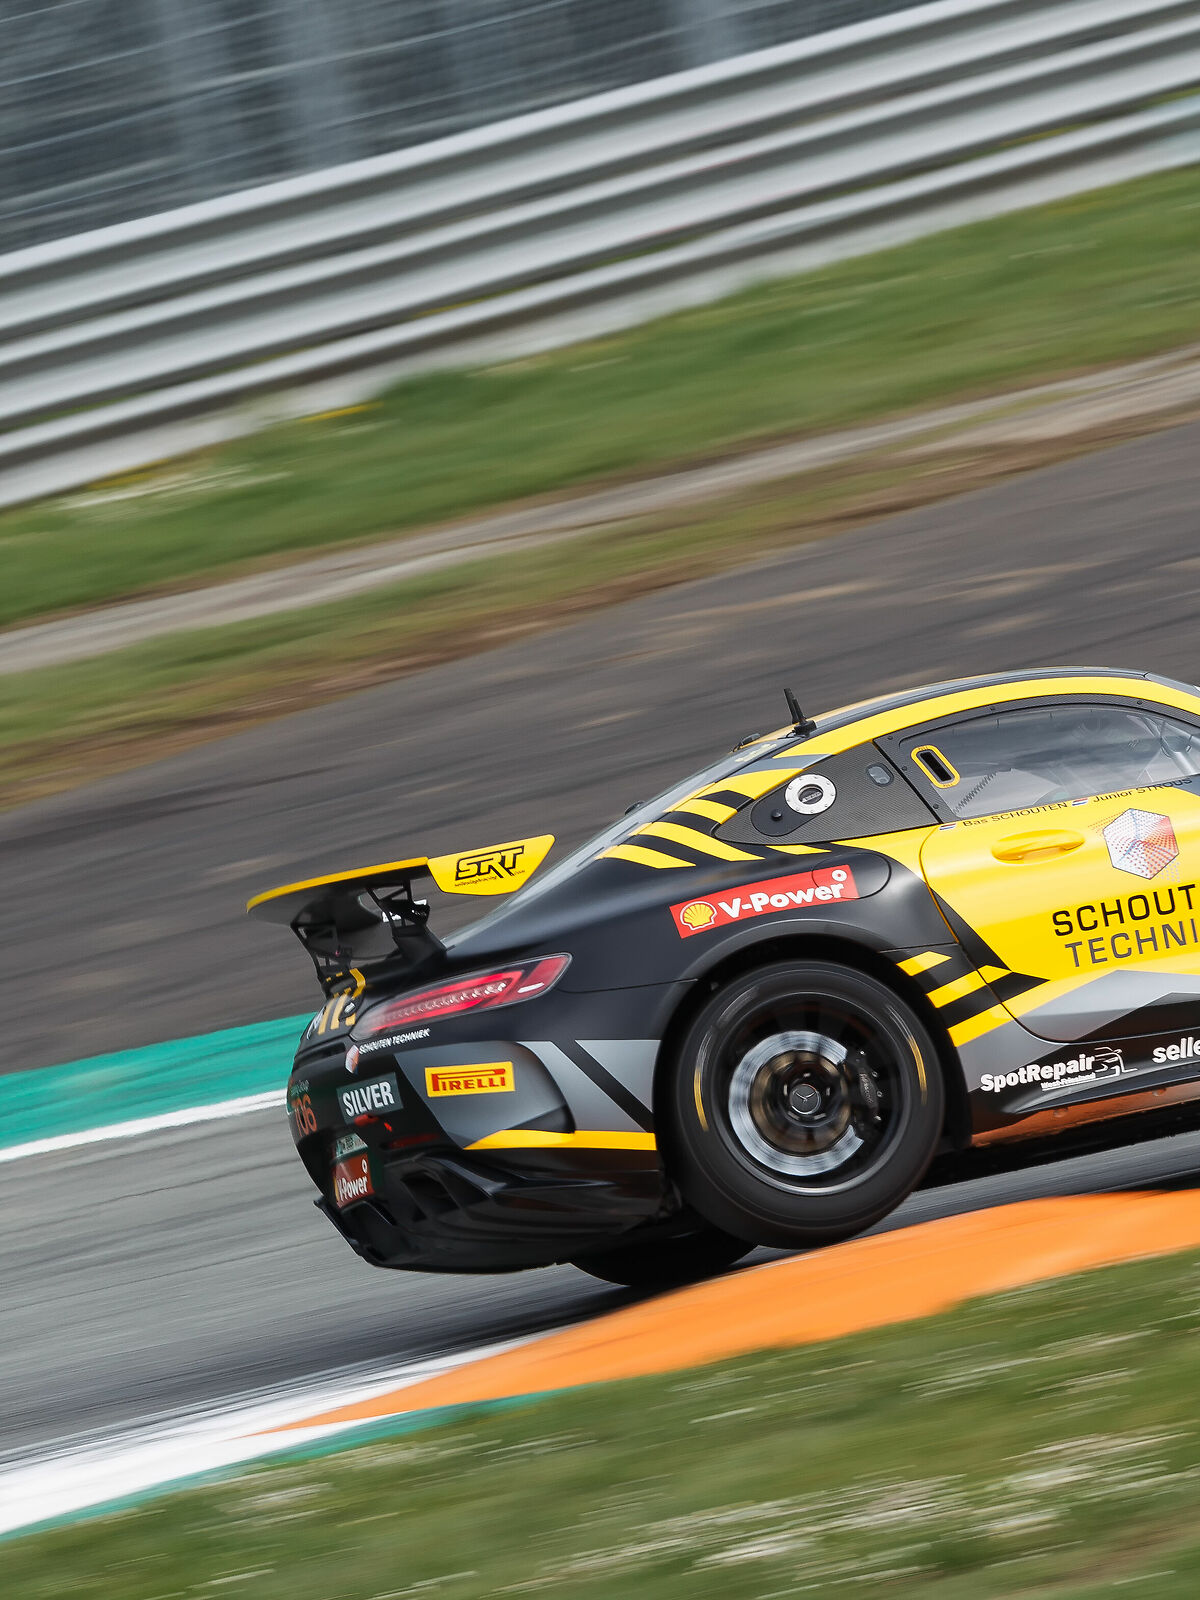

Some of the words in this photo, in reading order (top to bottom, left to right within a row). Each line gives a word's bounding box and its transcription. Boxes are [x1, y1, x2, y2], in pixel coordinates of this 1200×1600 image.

[1093, 789, 1133, 803] Junior
[962, 818, 988, 827] Bas
[991, 802, 1068, 822] SCHOUTEN
[455, 845, 525, 880] SRT
[718, 882, 844, 919] V-Power
[392, 1028, 431, 1045] TECHNIEK
[431, 1068, 506, 1092] PIRELLI
[980, 1054, 1095, 1093] SpotRepair
[342, 1081, 395, 1117] SILVER
